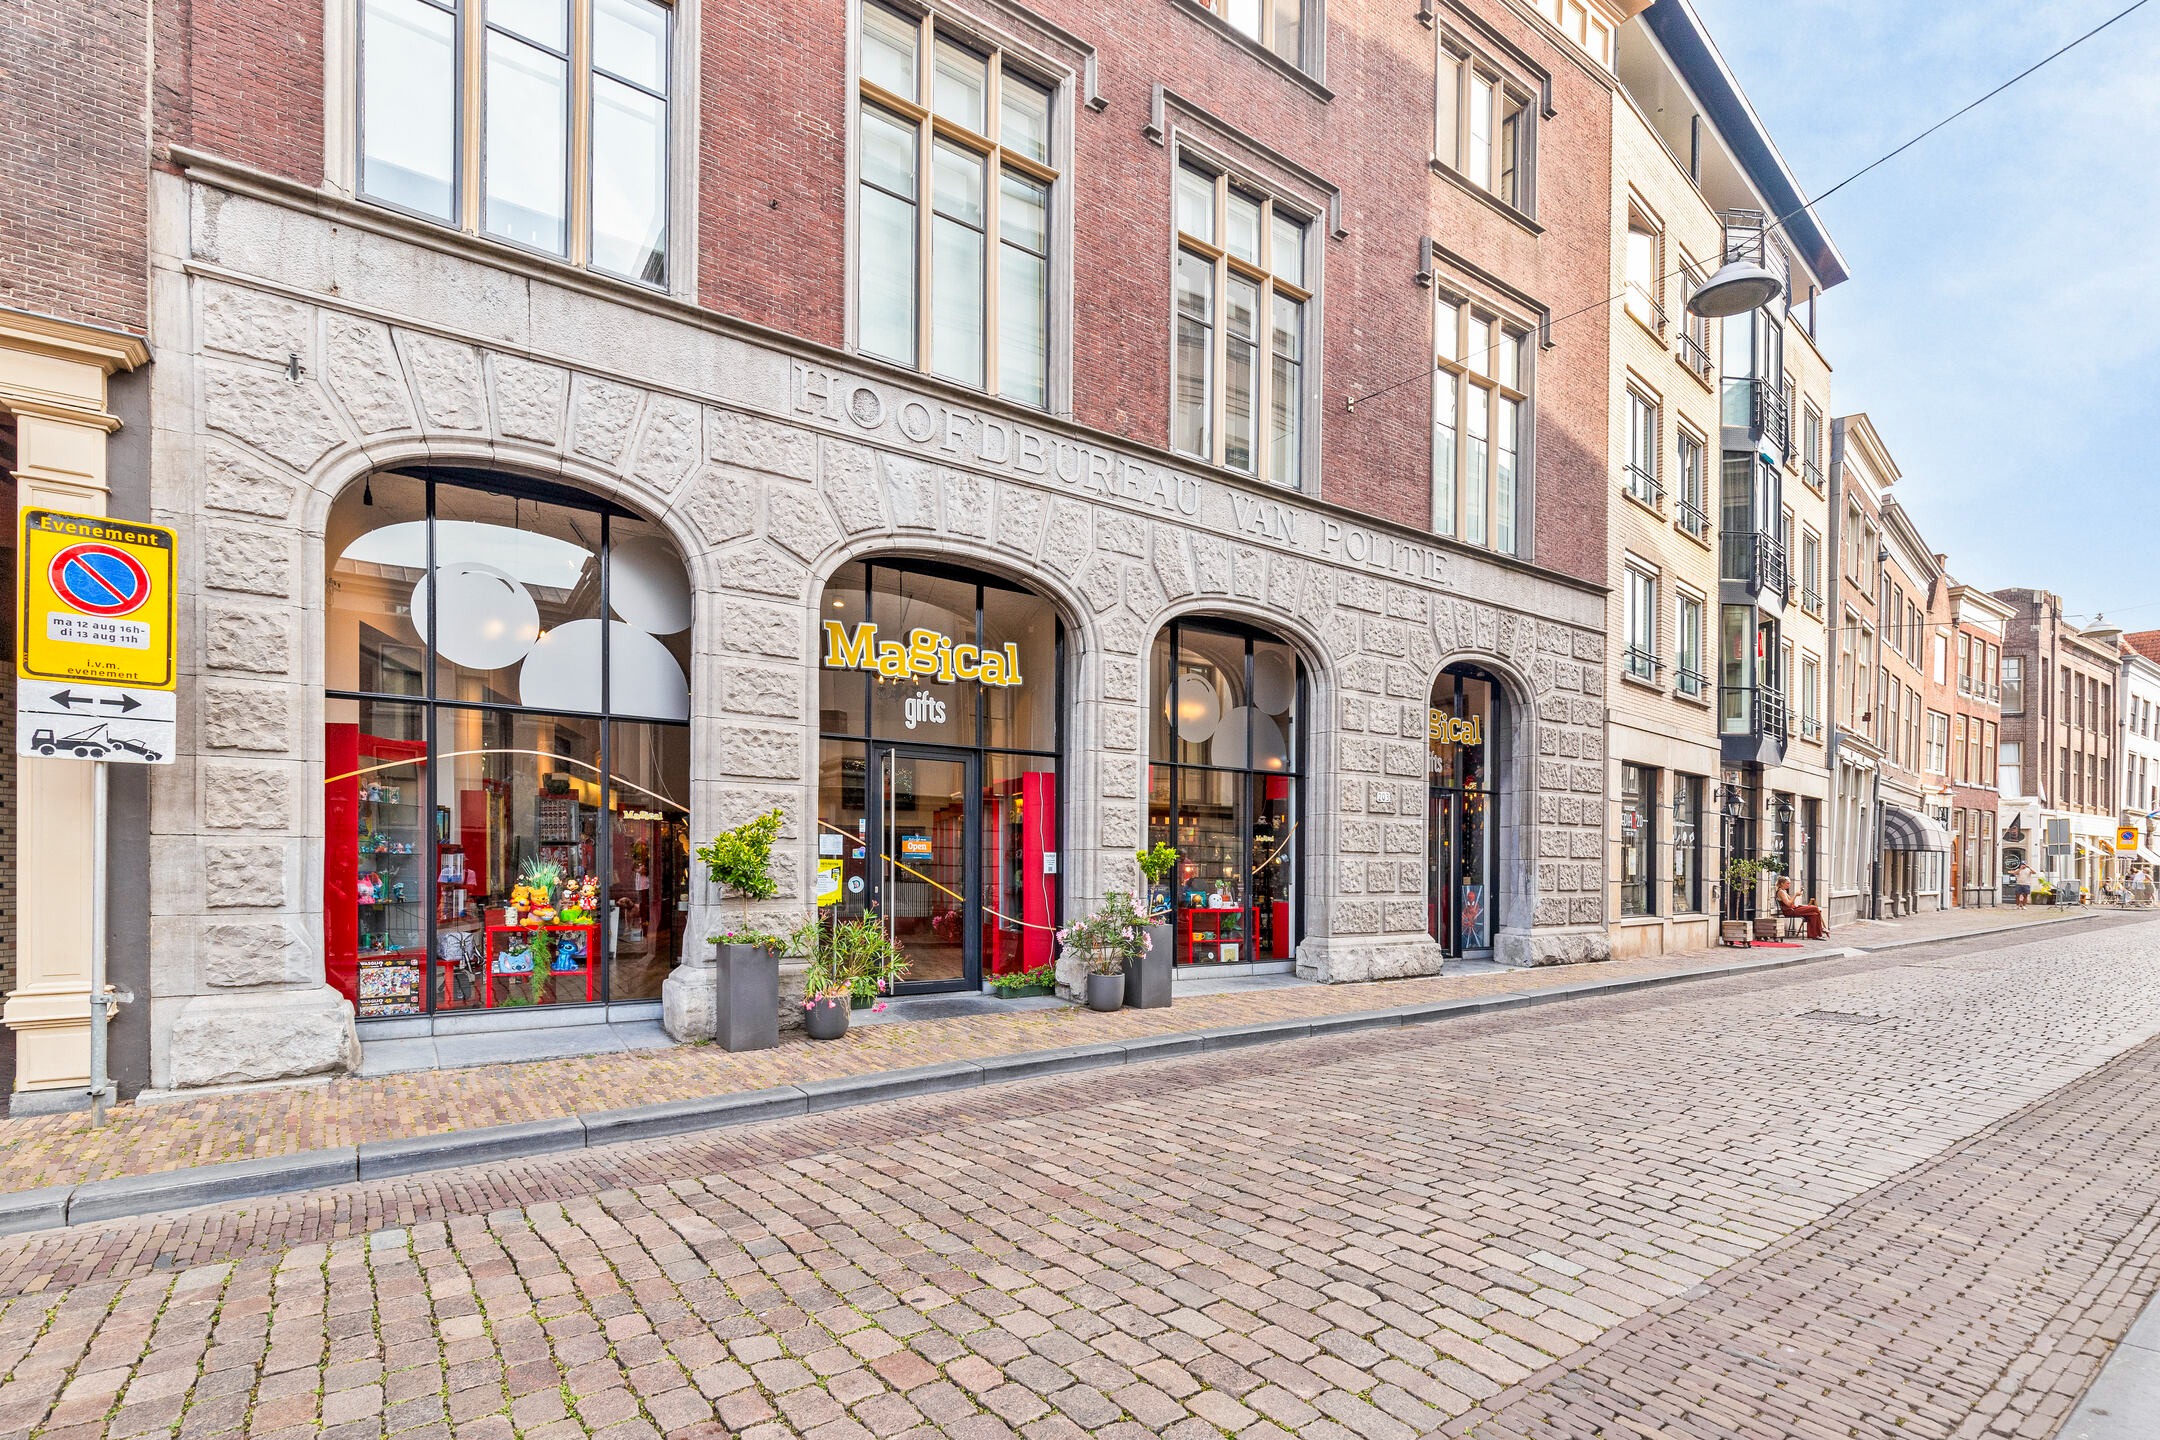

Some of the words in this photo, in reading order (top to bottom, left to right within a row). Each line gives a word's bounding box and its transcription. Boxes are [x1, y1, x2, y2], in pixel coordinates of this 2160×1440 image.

[795, 365, 1203, 517] HOOFDBUREAU
[1228, 490, 1299, 545] VAN
[1321, 519, 1449, 585] POLITIE
[40, 516, 159, 546] Evenement
[53, 618, 72, 627] ma
[77, 620, 88, 629] 12
[92, 622, 116, 633] aug
[120, 625, 146, 634] 16h-
[60, 628, 72, 637] di
[77, 630, 88, 639] 13
[92, 632, 116, 643] aug
[120, 635, 138, 643] 11h
[823, 619, 1023, 687] Magical
[87, 659, 120, 671] i.v.m.
[67, 667, 139, 680] evenement
[905, 690, 946, 730] gifts
[907, 842, 927, 852] Open
